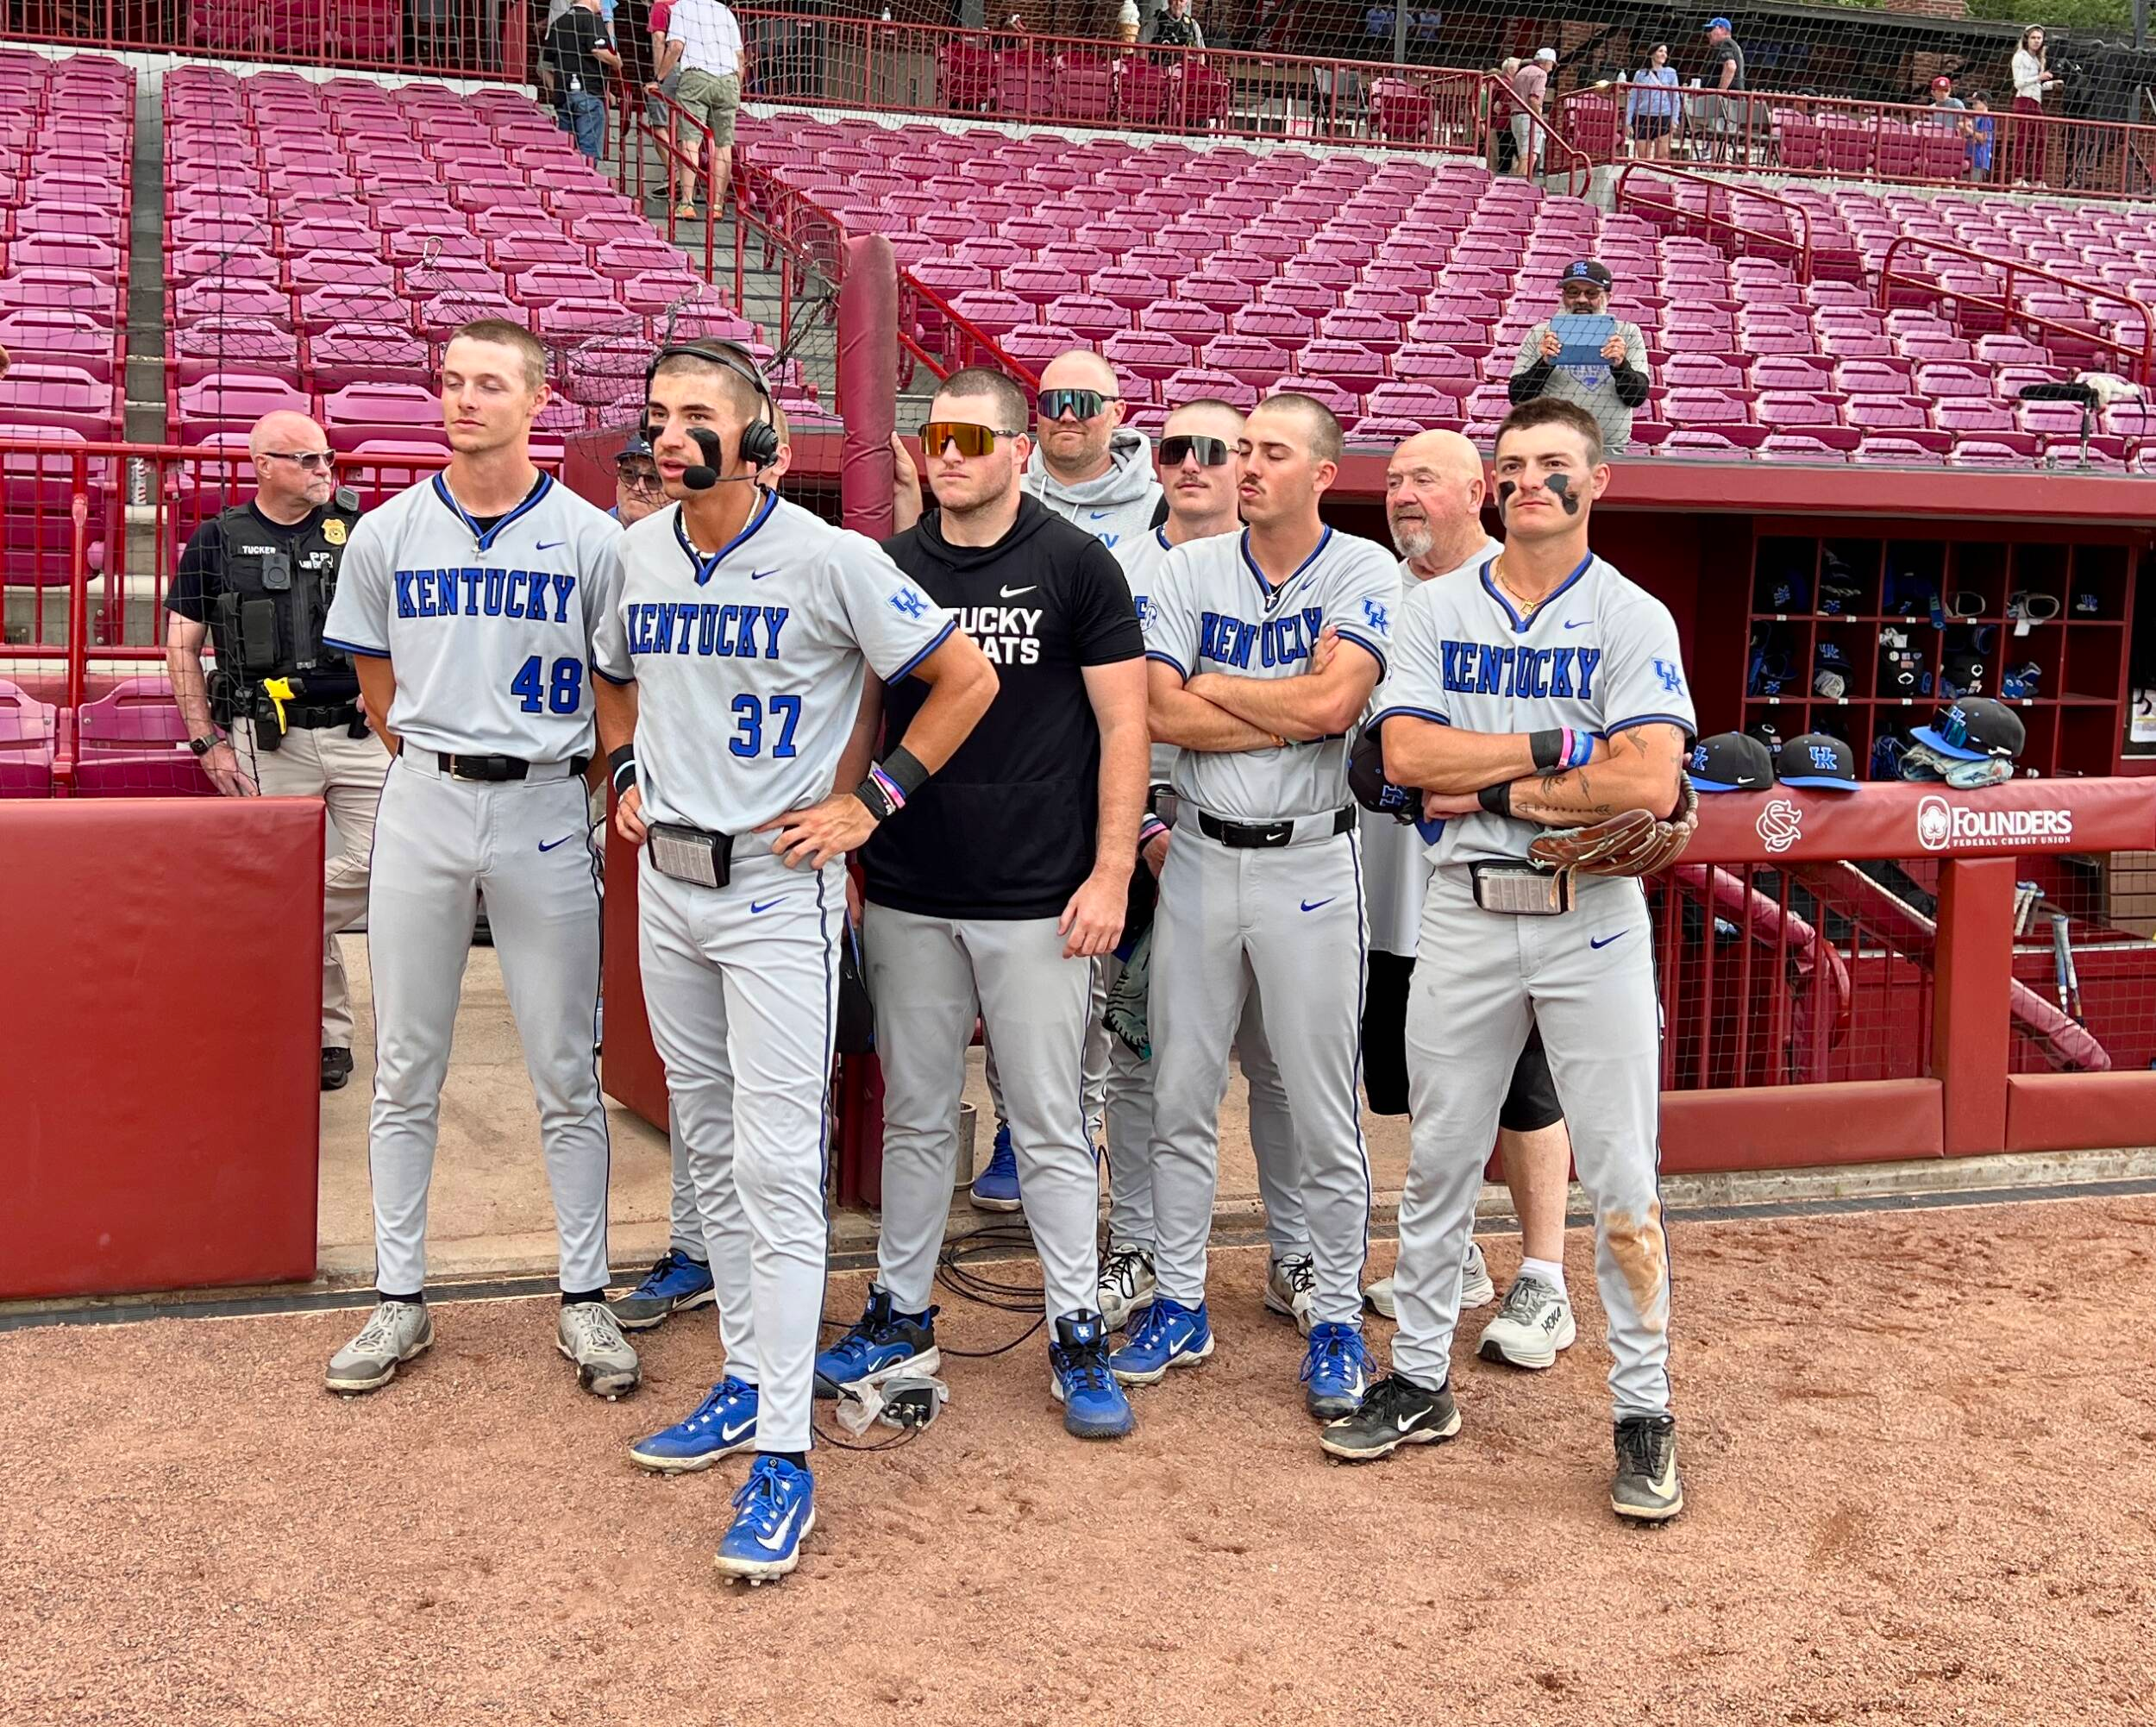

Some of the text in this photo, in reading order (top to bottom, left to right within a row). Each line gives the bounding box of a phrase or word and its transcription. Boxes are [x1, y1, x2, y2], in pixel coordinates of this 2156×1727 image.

[242, 545, 276, 555] TUCKER
[394, 568, 576, 624] KENTUCKY
[628, 603, 790, 660] KENTUCKY
[974, 637, 1040, 664] ATS
[1200, 606, 1323, 671] KENUCY
[511, 655, 584, 715] 48
[1440, 640, 1601, 700] KENTUCKY
[729, 694, 802, 758] 37
[1808, 745, 1838, 770] UK
[1952, 807, 2072, 837] FOUNDERS
[1953, 838, 1998, 847] FEDERAL
[2040, 836, 2071, 845] UNION
[1540, 1305, 1563, 1336] HOKA
